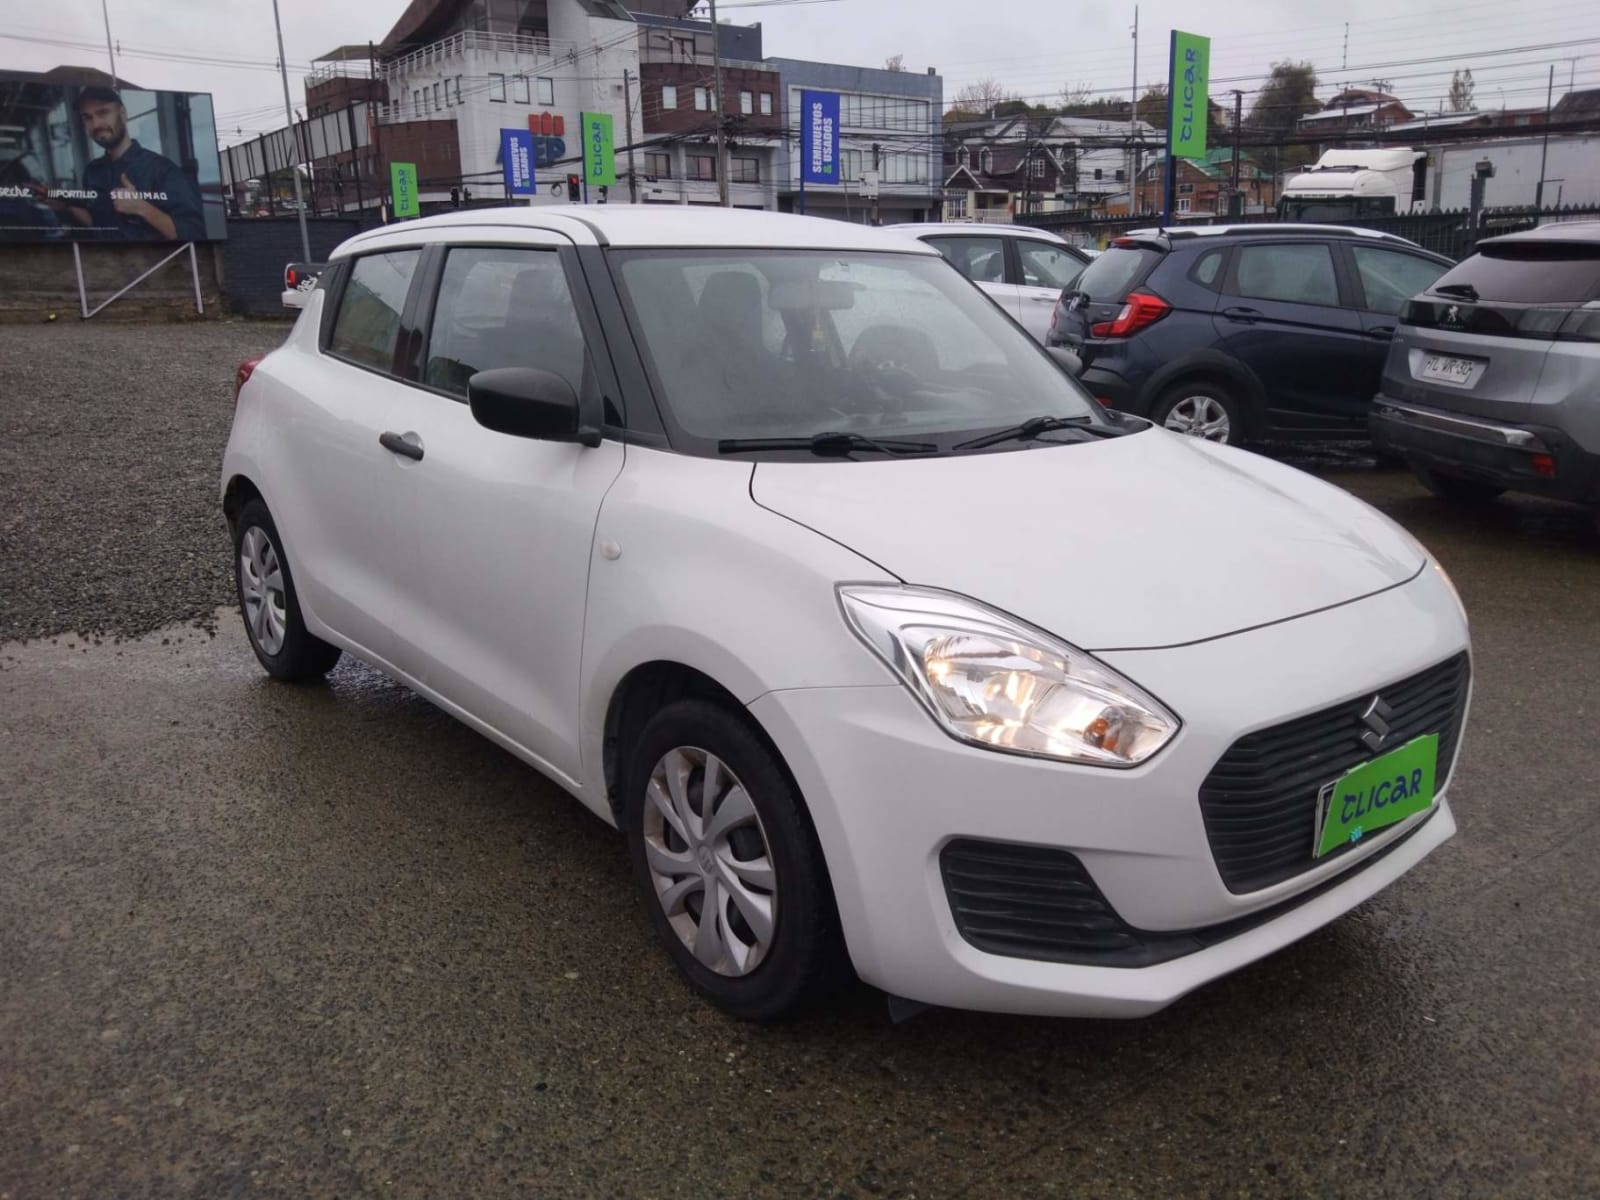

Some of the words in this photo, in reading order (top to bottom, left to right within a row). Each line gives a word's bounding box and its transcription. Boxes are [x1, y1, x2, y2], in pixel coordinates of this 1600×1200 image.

[812, 102, 823, 173] SEMINUEVOS
[823, 117, 833, 163] USADOS
[110, 190, 169, 201] SERVIMAQ
